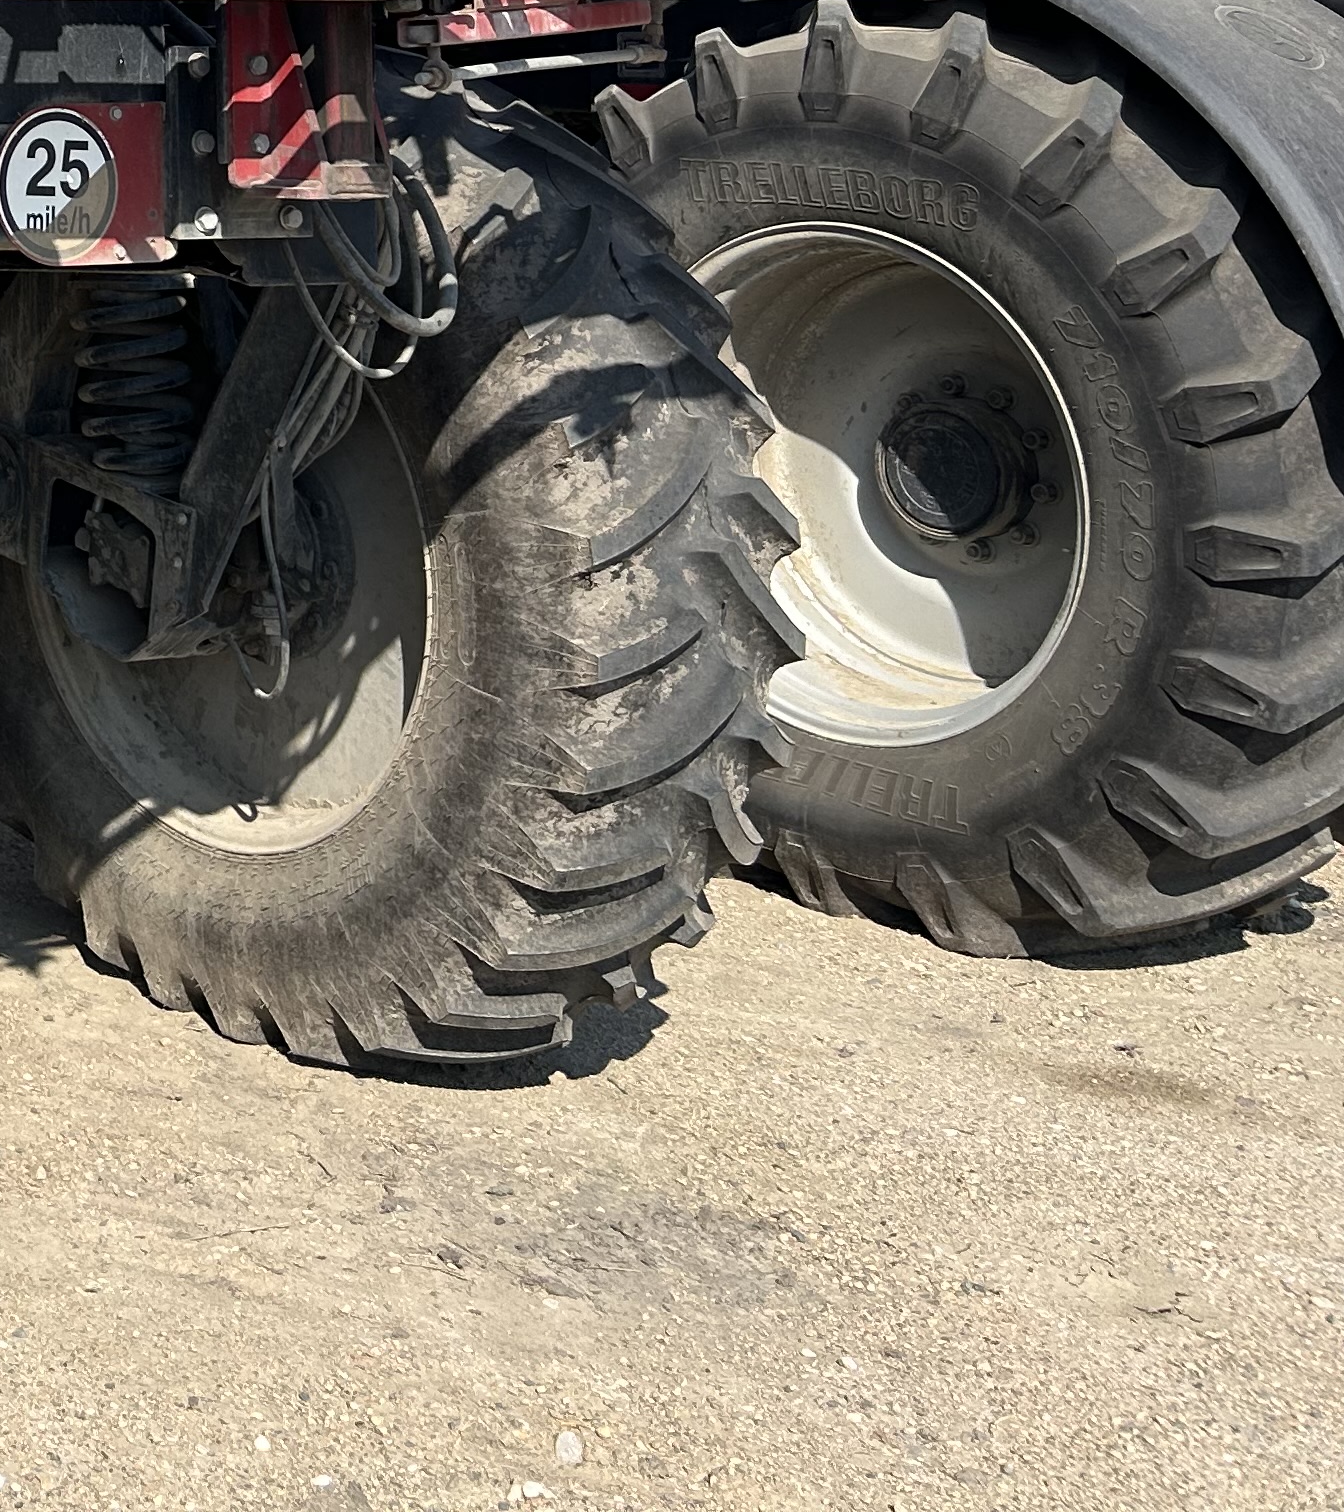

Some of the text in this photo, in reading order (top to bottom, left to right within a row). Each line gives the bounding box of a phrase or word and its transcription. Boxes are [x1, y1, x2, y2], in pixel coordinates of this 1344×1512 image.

[25, 137, 90, 199] 25
[679, 156, 981, 232] TRELLEBORG
[26, 205, 92, 235] mile/h
[758, 745, 971, 837] TRELLE
